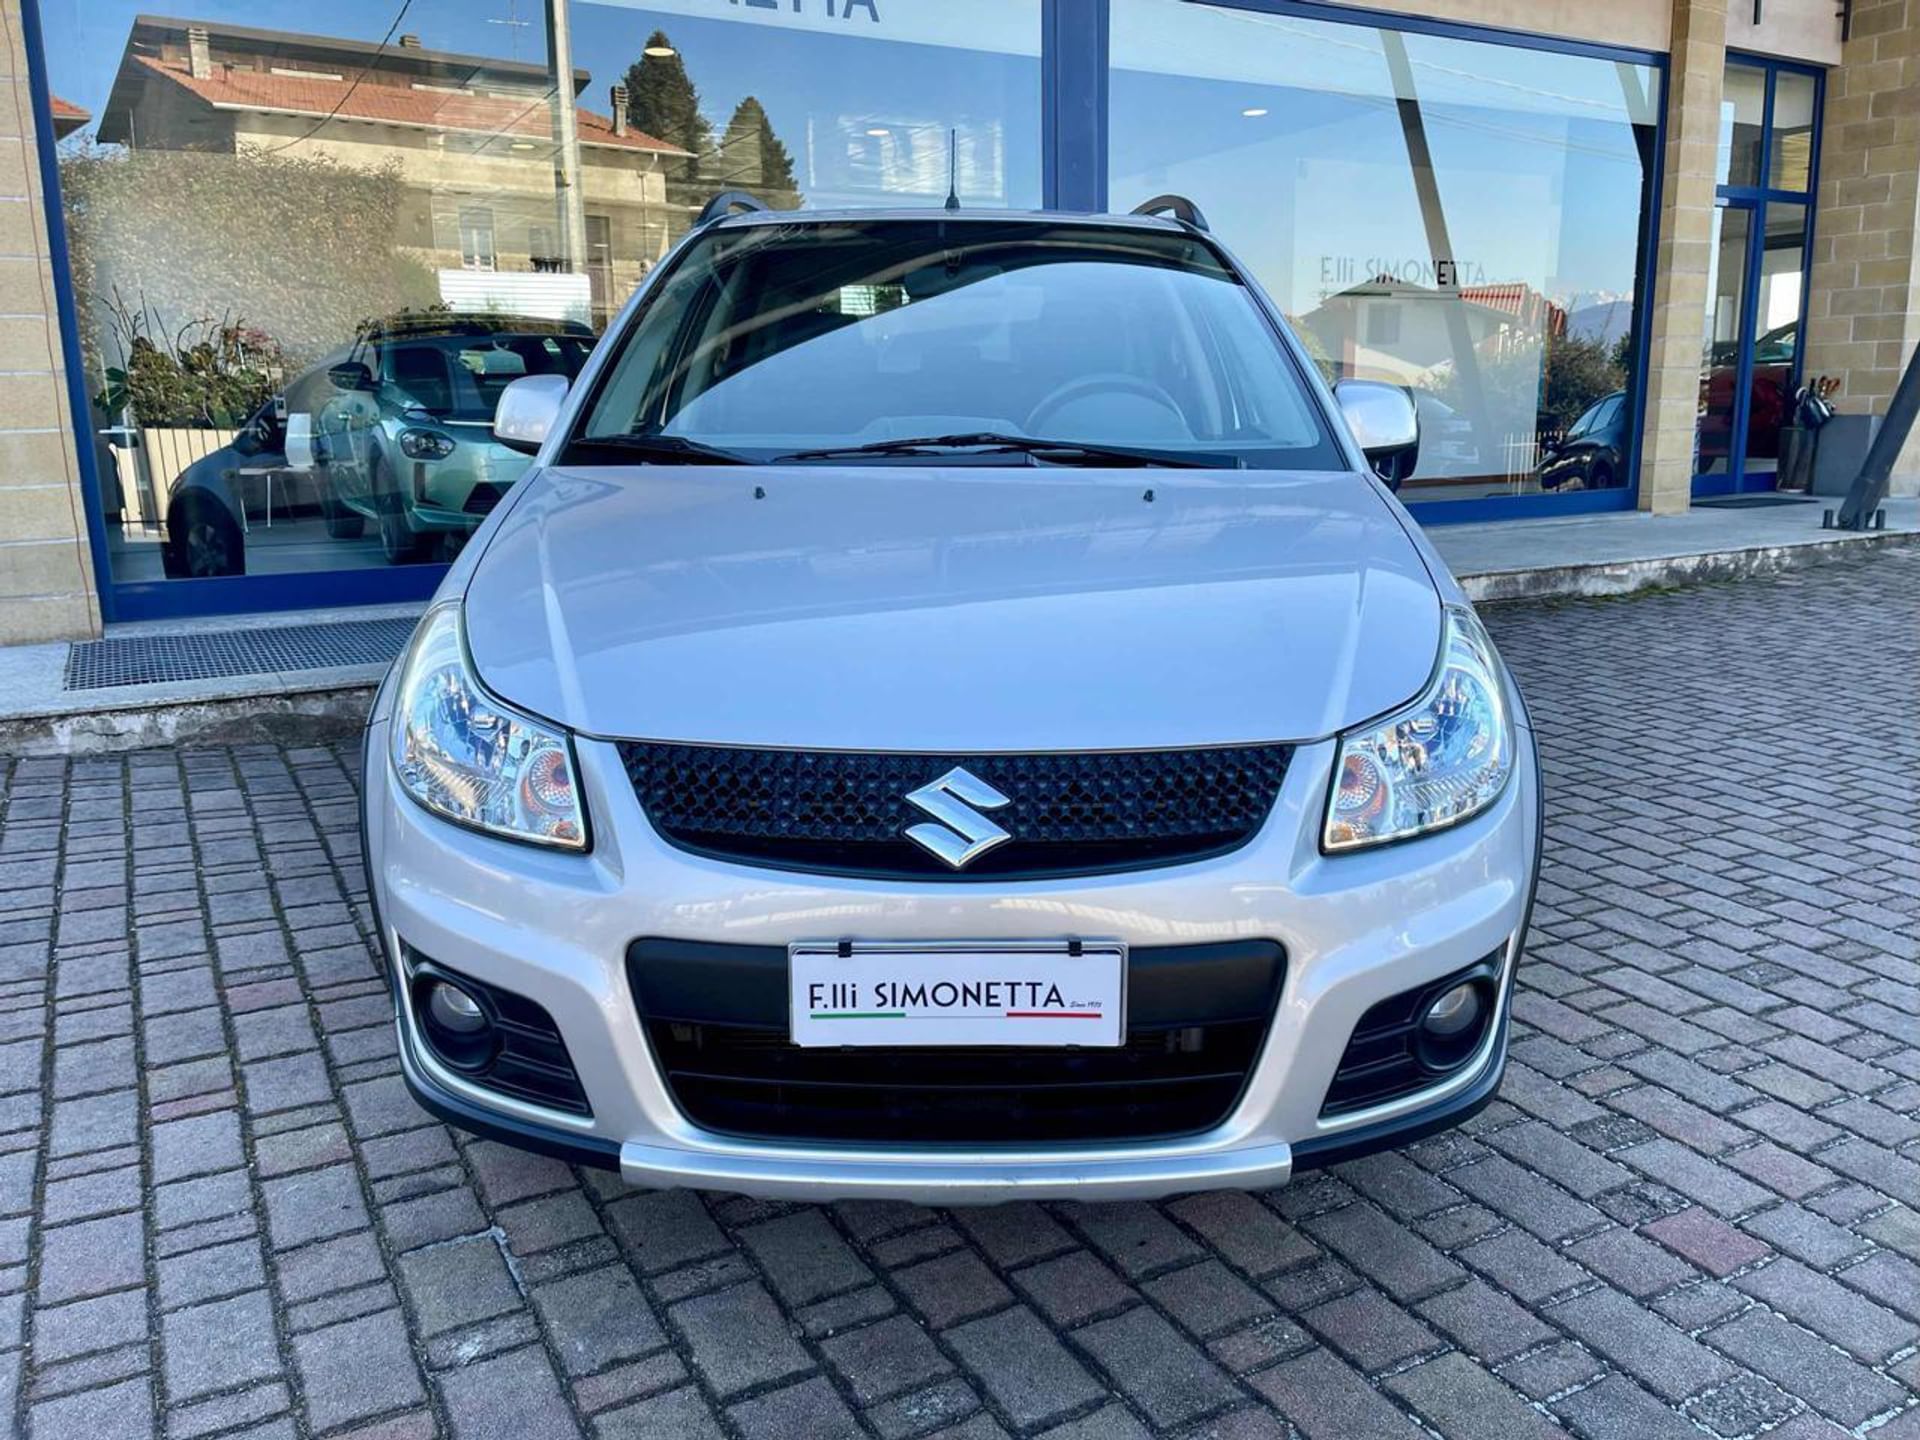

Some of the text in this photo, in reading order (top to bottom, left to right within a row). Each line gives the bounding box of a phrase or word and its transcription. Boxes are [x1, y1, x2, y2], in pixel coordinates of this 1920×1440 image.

[1366, 258, 1486, 285] SIMONETTA
[809, 983, 857, 1009] F.lli
[874, 982, 1065, 1008] SIMONETTA
